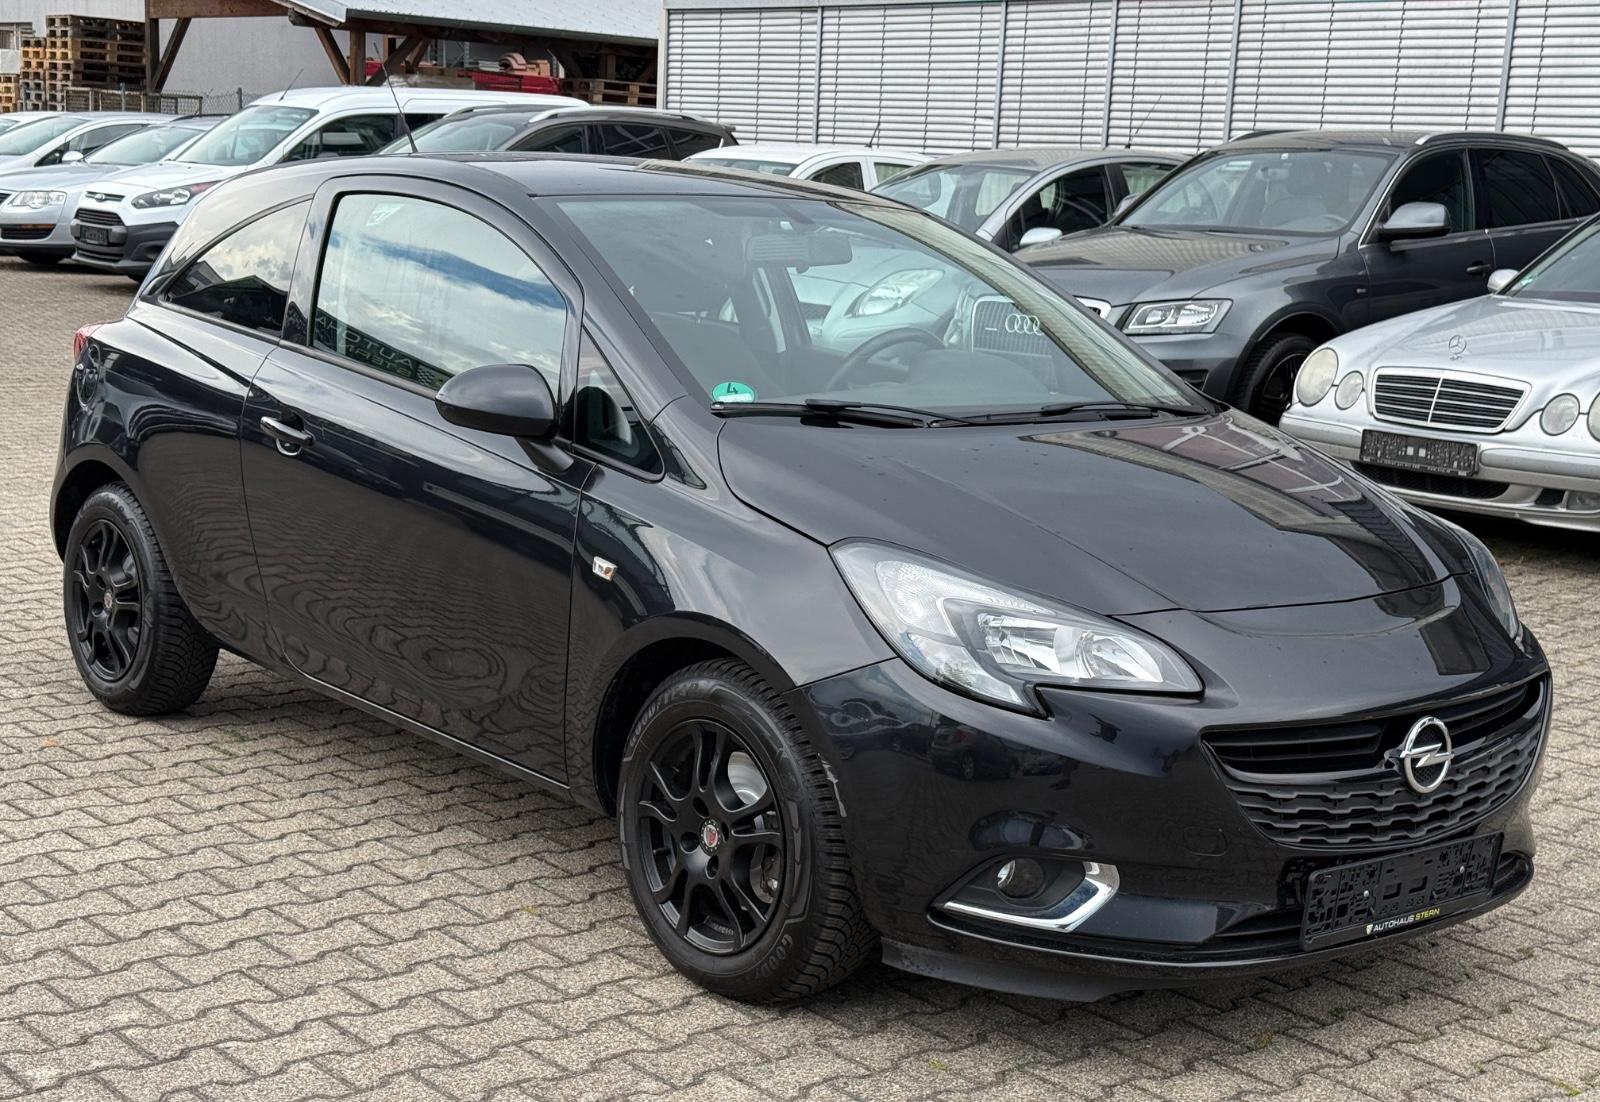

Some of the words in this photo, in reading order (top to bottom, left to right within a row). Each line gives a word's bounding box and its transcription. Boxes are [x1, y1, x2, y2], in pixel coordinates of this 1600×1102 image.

[726, 382, 739, 395] 4
[1373, 914, 1415, 932] AUTOHAUS
[1415, 908, 1441, 921] STERN
